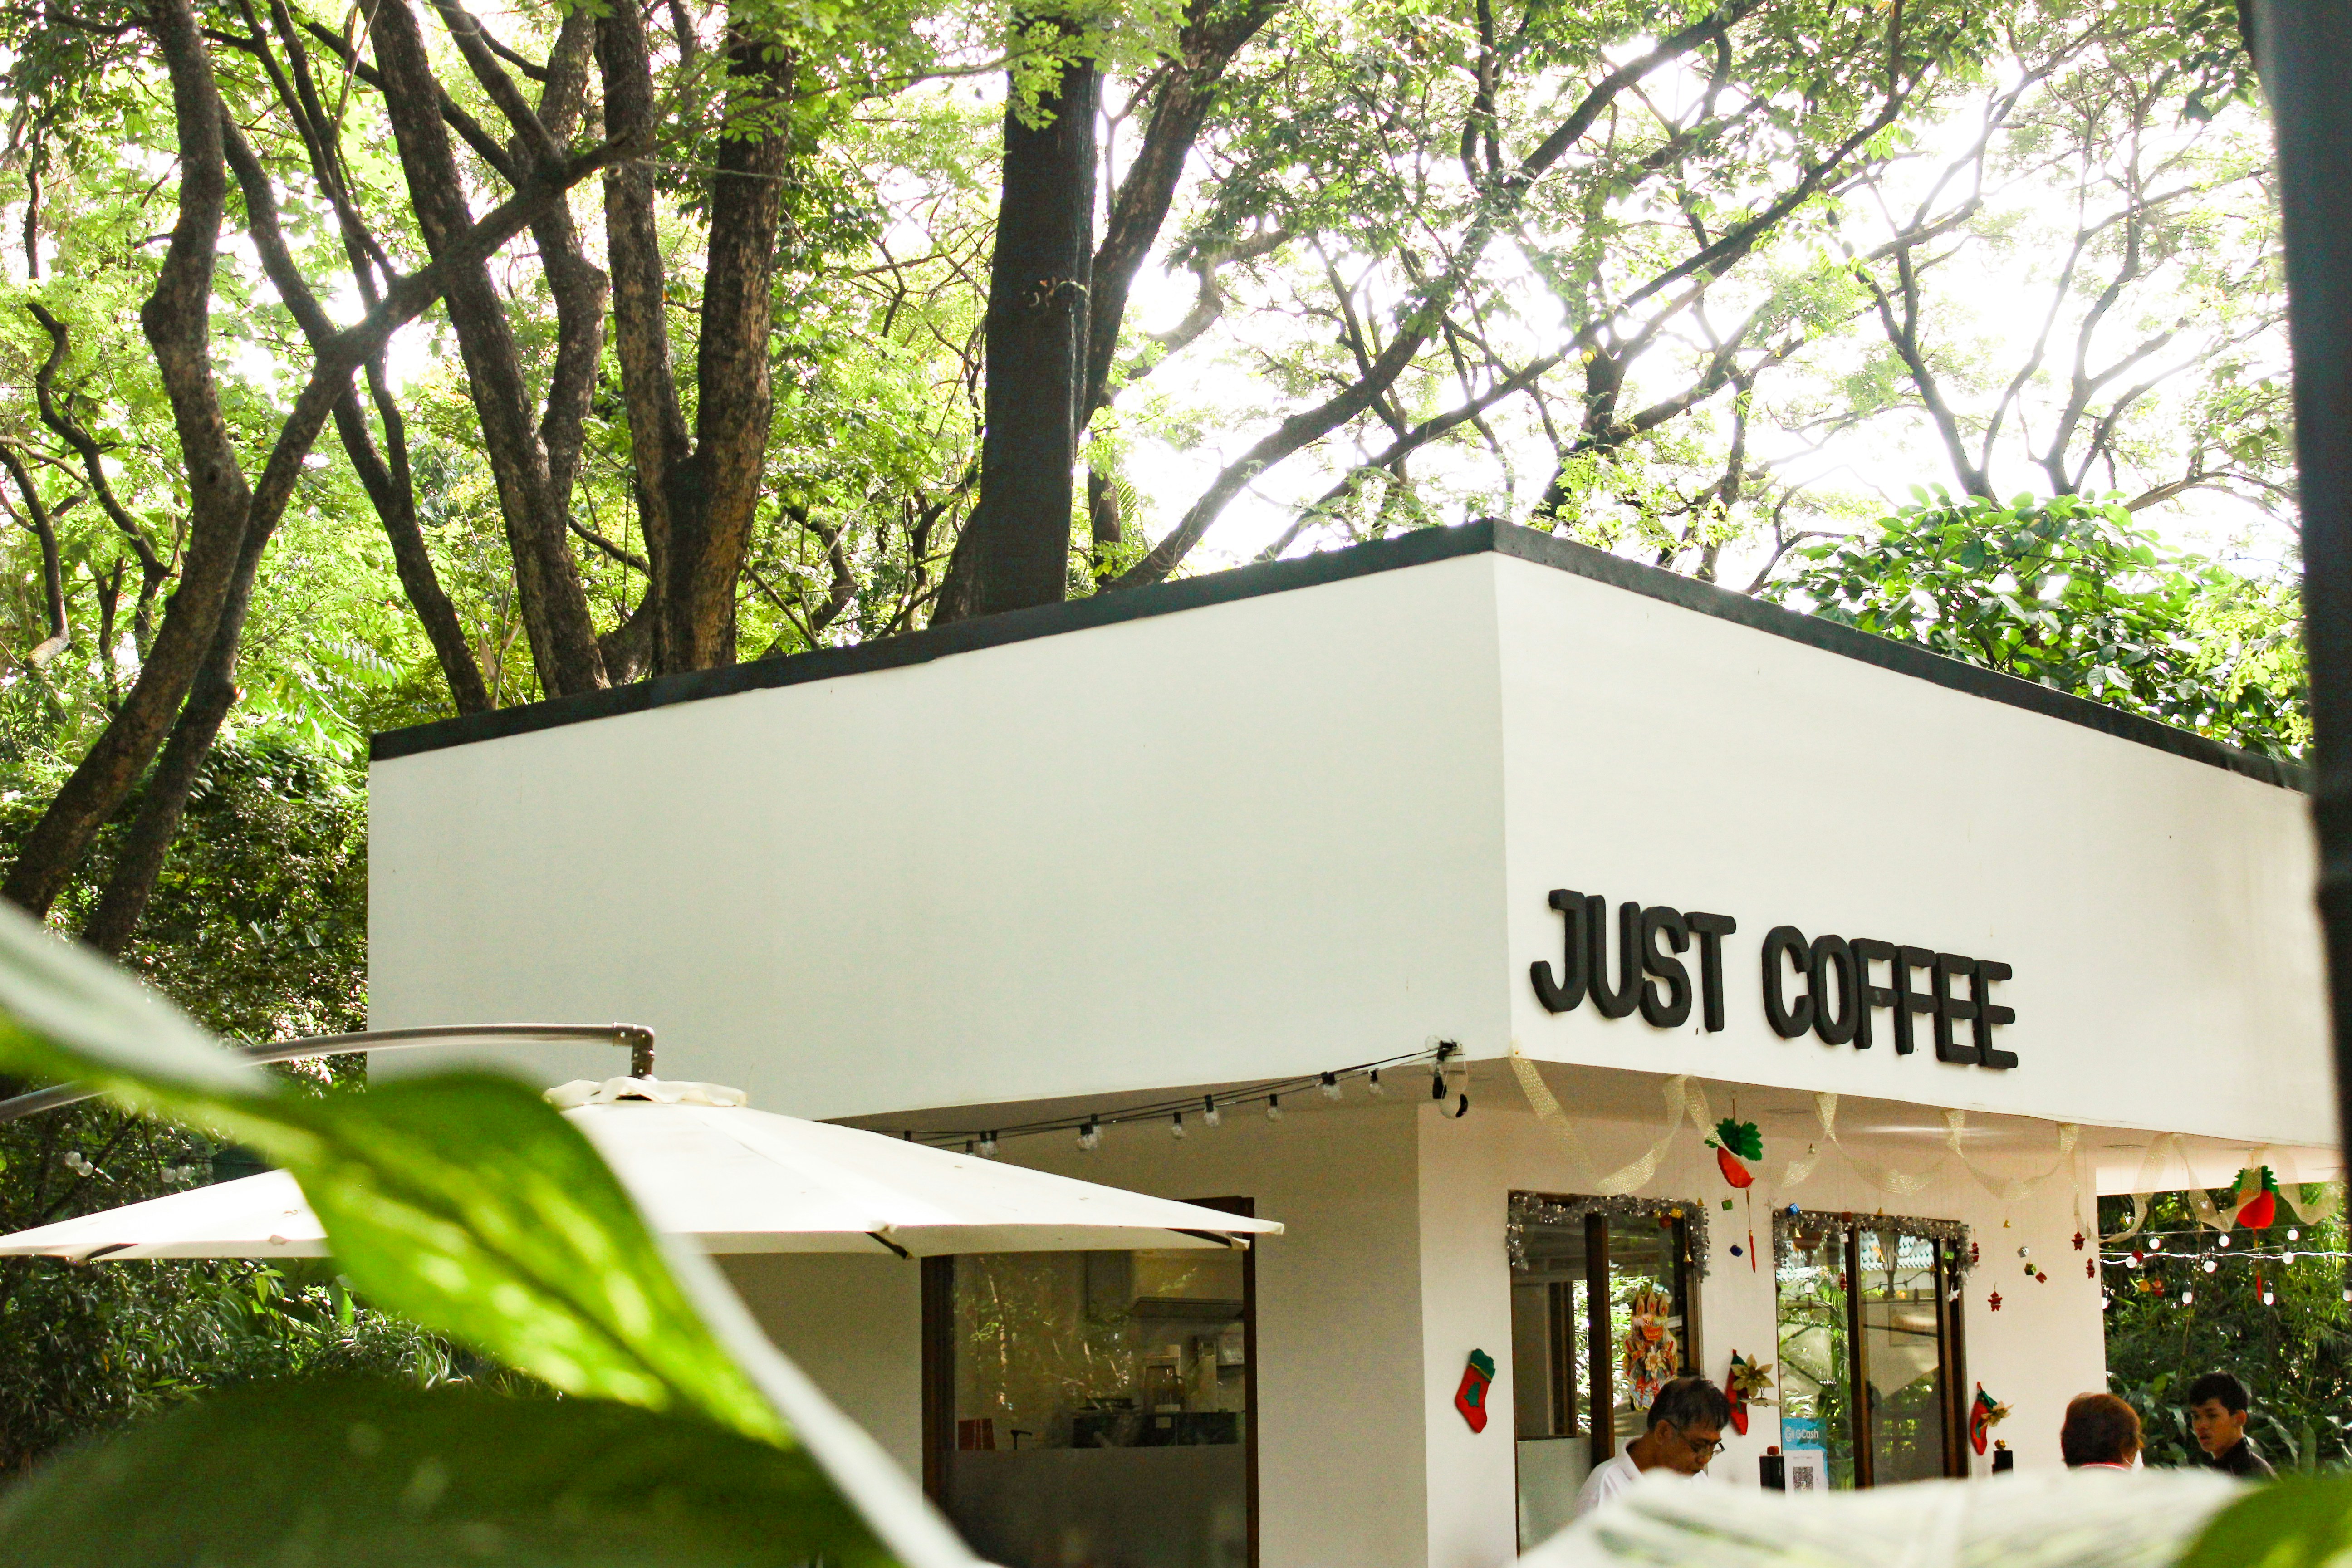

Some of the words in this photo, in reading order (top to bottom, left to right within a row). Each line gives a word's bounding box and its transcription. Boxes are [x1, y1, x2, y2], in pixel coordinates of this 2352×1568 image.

[1530, 888, 1737, 1033] JUST
[1762, 925, 2019, 1069] COFFEE
[1796, 1428, 1818, 1439] GCash
